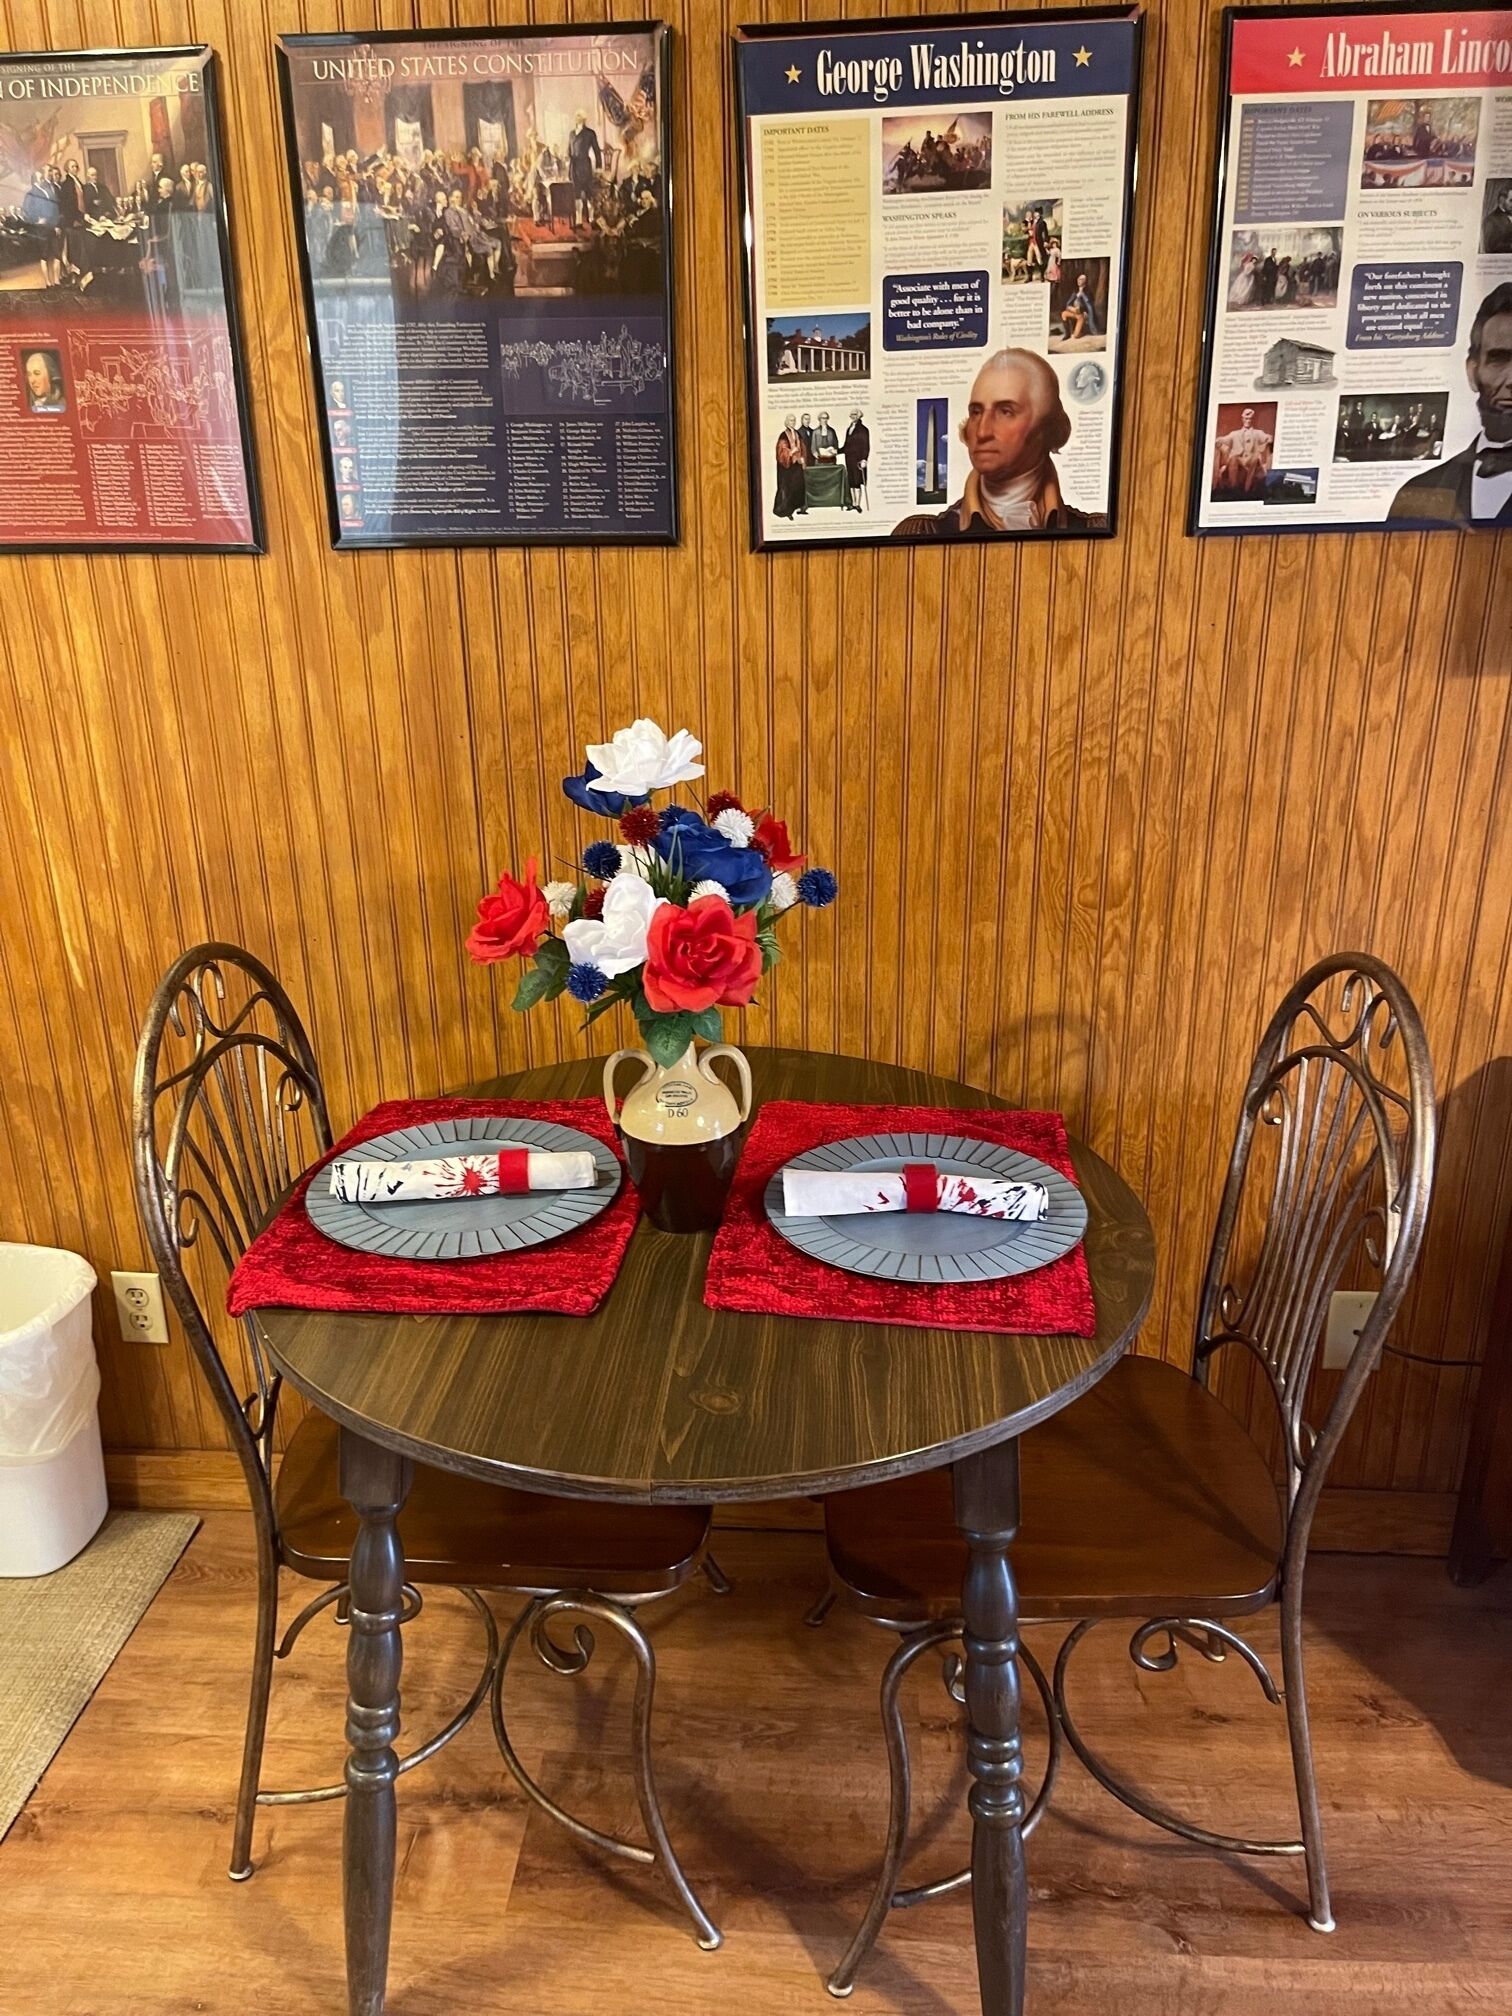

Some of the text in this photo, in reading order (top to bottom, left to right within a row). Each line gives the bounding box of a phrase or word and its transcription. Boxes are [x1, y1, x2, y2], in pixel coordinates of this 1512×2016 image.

[1319, 28, 1512, 78] Abraham Linco
[312, 50, 638, 80] UNITED STATES CONSTITUTION
[816, 40, 1056, 102] George Washington
[8, 79, 35, 99] OF
[40, 72, 199, 98] INDEPENDENCE
[1042, 109, 1079, 119] FAREWELL
[1081, 108, 1114, 117] ADDRESS
[763, 126, 829, 136] IMPORTANT DATES
[882, 214, 930, 222] WASHINGTON
[1370, 210, 1401, 218] VARIOUS
[1422, 270, 1451, 280] brought
[933, 281, 950, 291] with
[970, 279, 981, 289] of
[1395, 281, 1408, 289] this
[1409, 281, 1442, 289] continent
[890, 296, 910, 308] good
[912, 295, 938, 307] quality
[953, 293, 965, 303] for
[966, 293, 973, 302] it
[974, 292, 981, 301] is
[1404, 291, 1439, 299] conceived
[888, 309, 911, 318] better
[922, 307, 931, 316] be
[933, 307, 954, 316] alone
[955, 305, 973, 314] than
[975, 305, 983, 314] in
[1357, 303, 1380, 313] liberty
[1396, 301, 1430, 310] dedicated
[1439, 301, 1451, 309] the
[906, 319, 921, 329] bad
